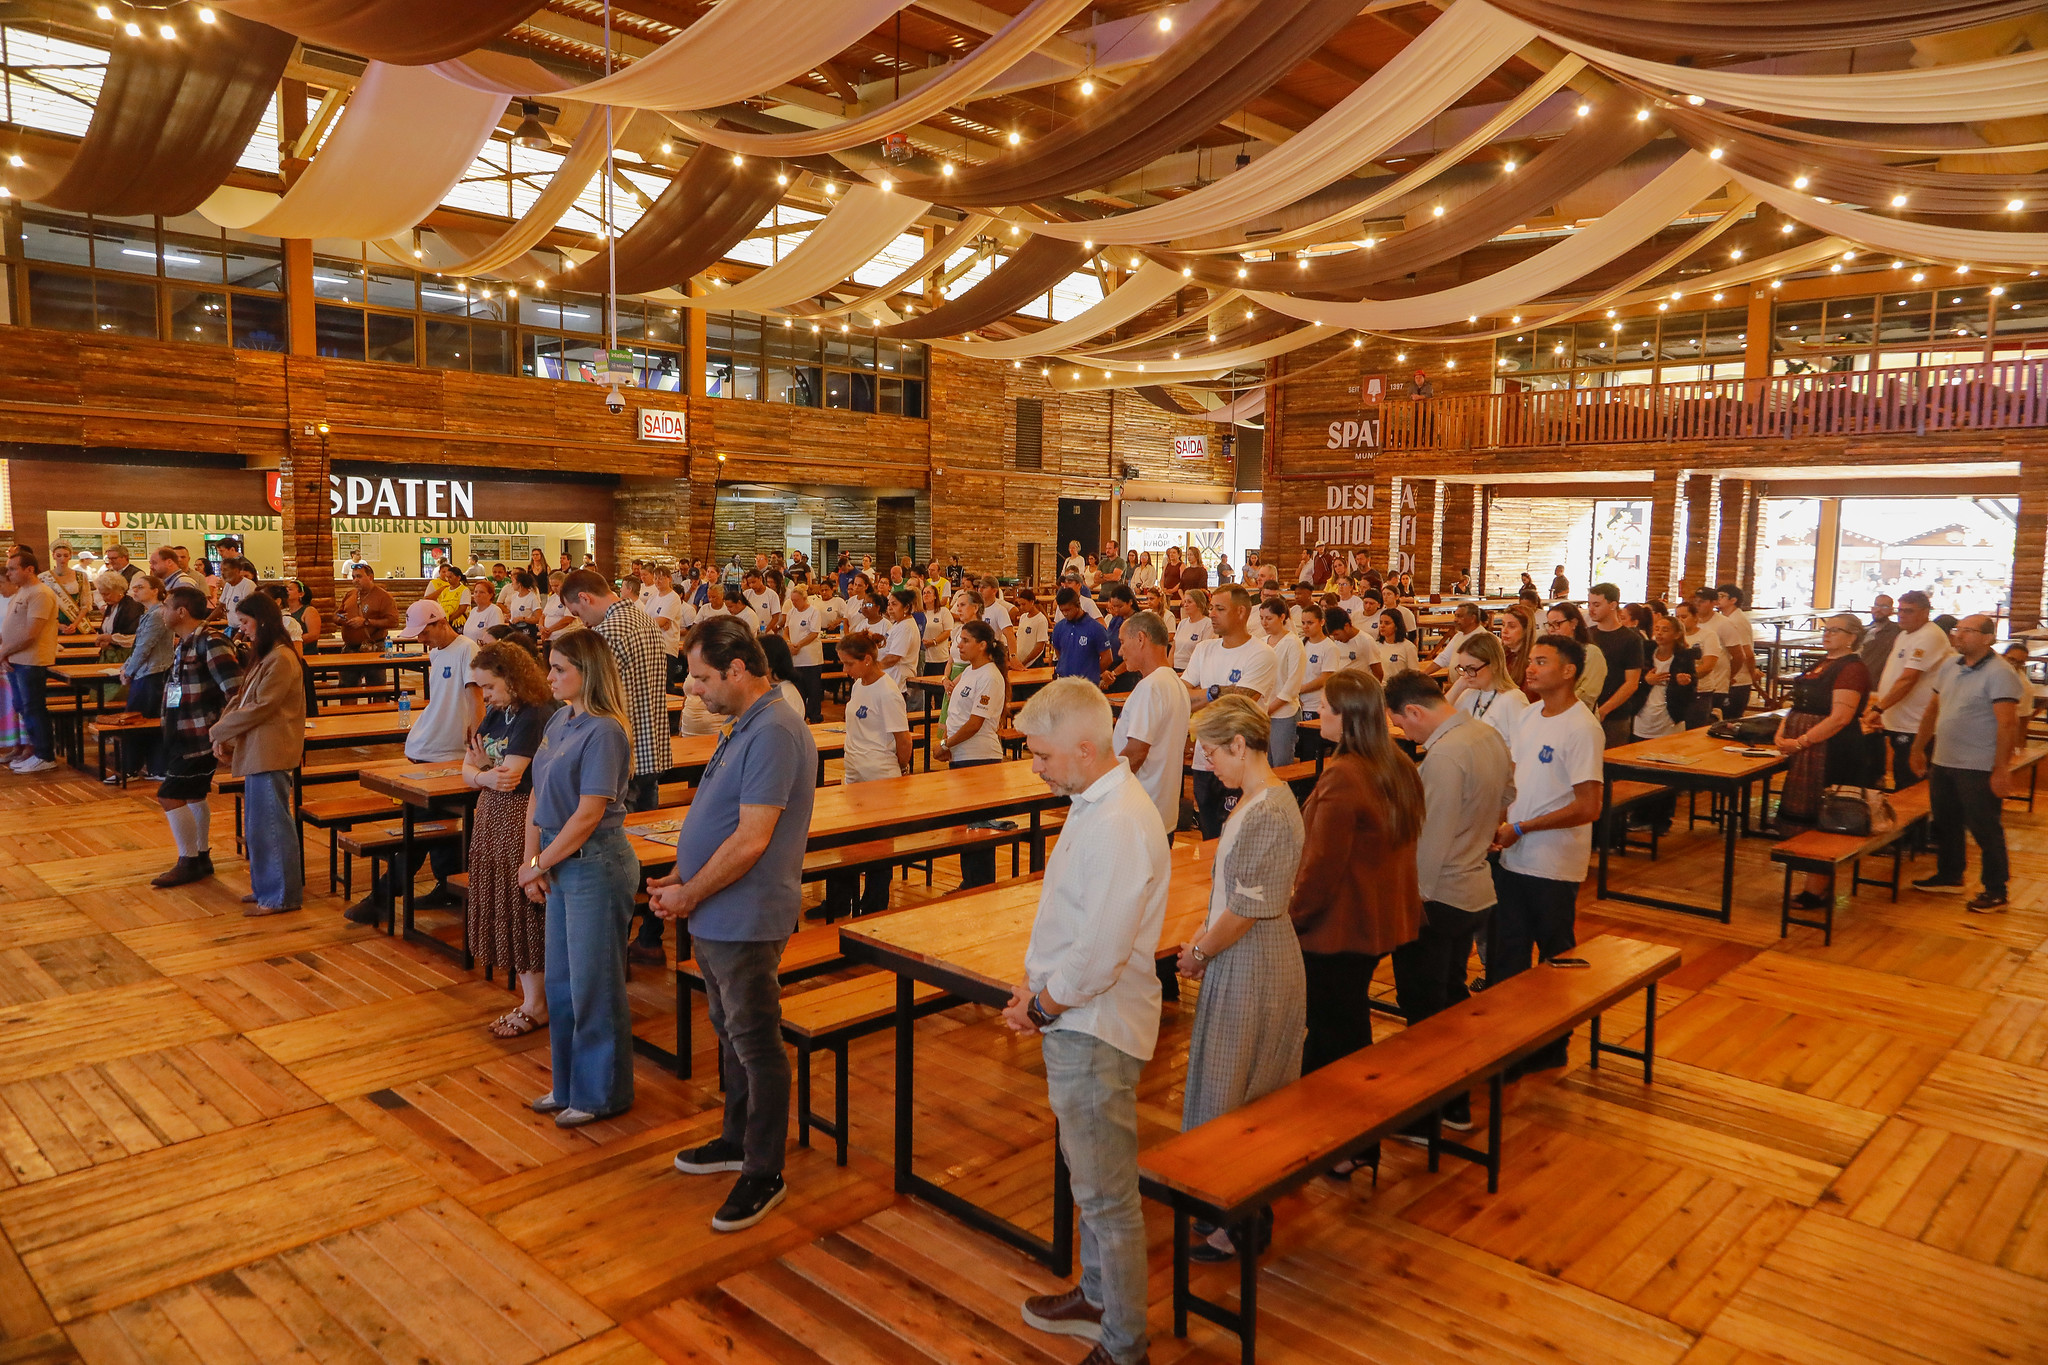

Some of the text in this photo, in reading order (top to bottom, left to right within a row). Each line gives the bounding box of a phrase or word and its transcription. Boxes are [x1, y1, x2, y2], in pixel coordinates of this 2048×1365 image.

[1390, 383, 1404, 391] 1397
[644, 412, 683, 435] SAÍDA
[1327, 420, 1380, 449] SPAT
[1175, 437, 1204, 454] SAÍDA
[330, 475, 474, 518] SPATEN
[126, 512, 278, 531] SPATEN DESDE
[331, 518, 528, 535] KTOBERFEST DO MUNDO
